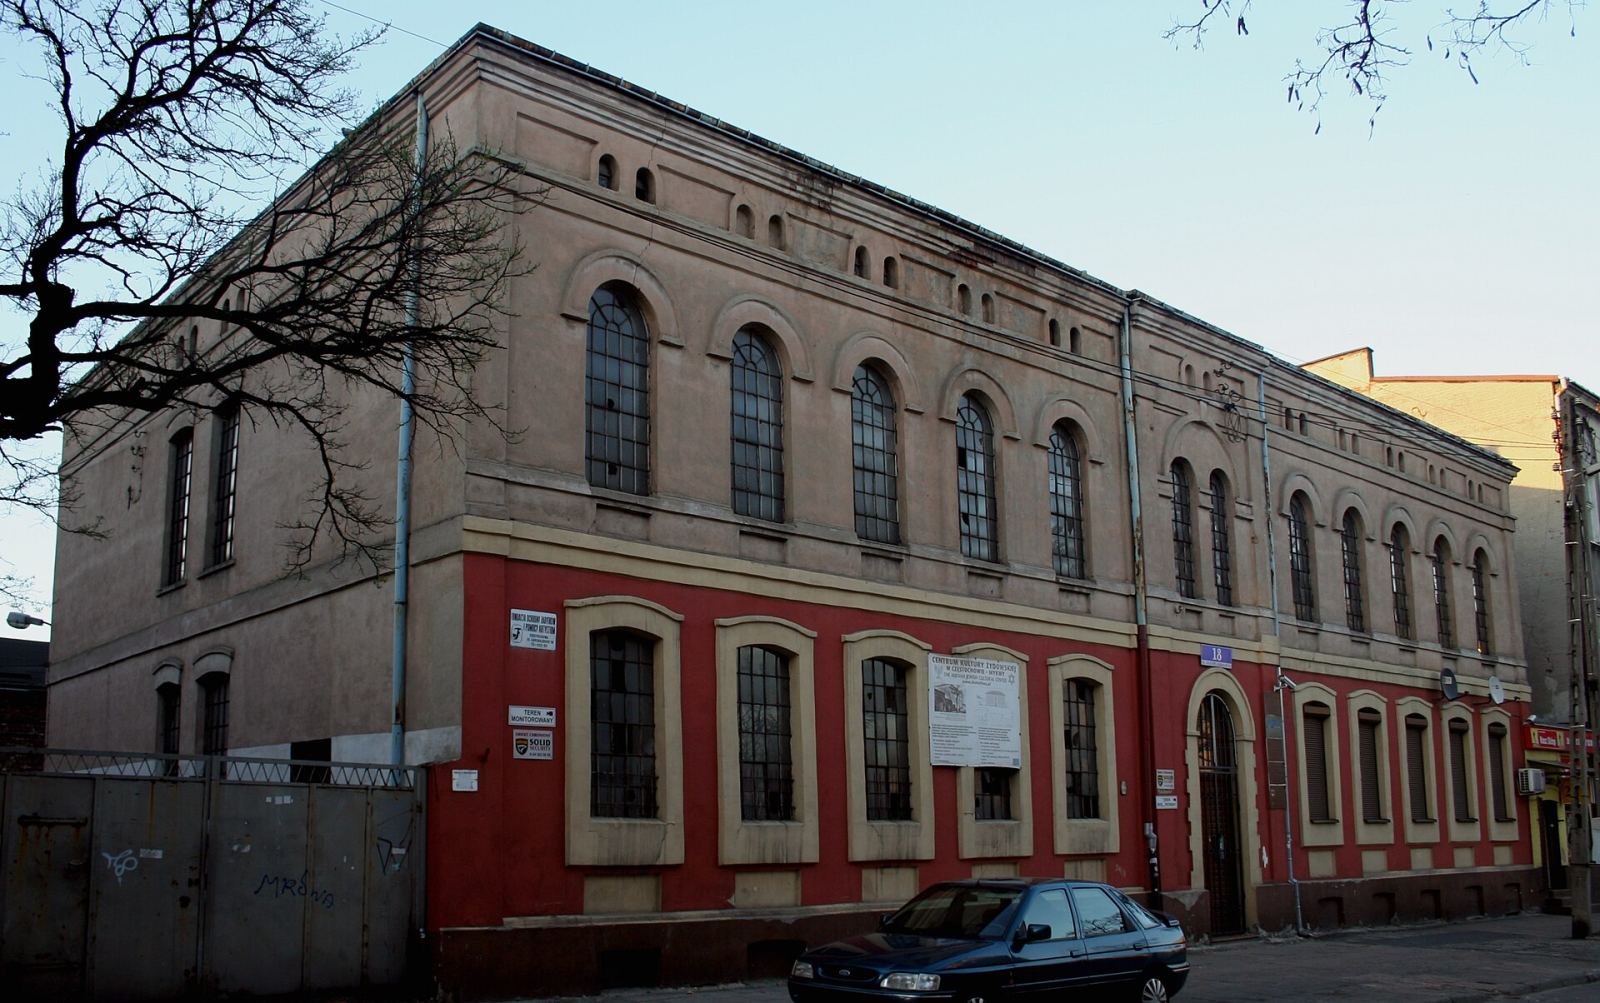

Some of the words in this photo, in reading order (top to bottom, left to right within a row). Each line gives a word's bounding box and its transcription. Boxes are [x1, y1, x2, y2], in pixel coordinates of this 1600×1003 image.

[1212, 647, 1222, 661] 18
[932, 656, 958, 665] CENTRUM
[960, 659, 984, 668] KULTURY
[511, 715, 554, 723] MONITOROWANY
